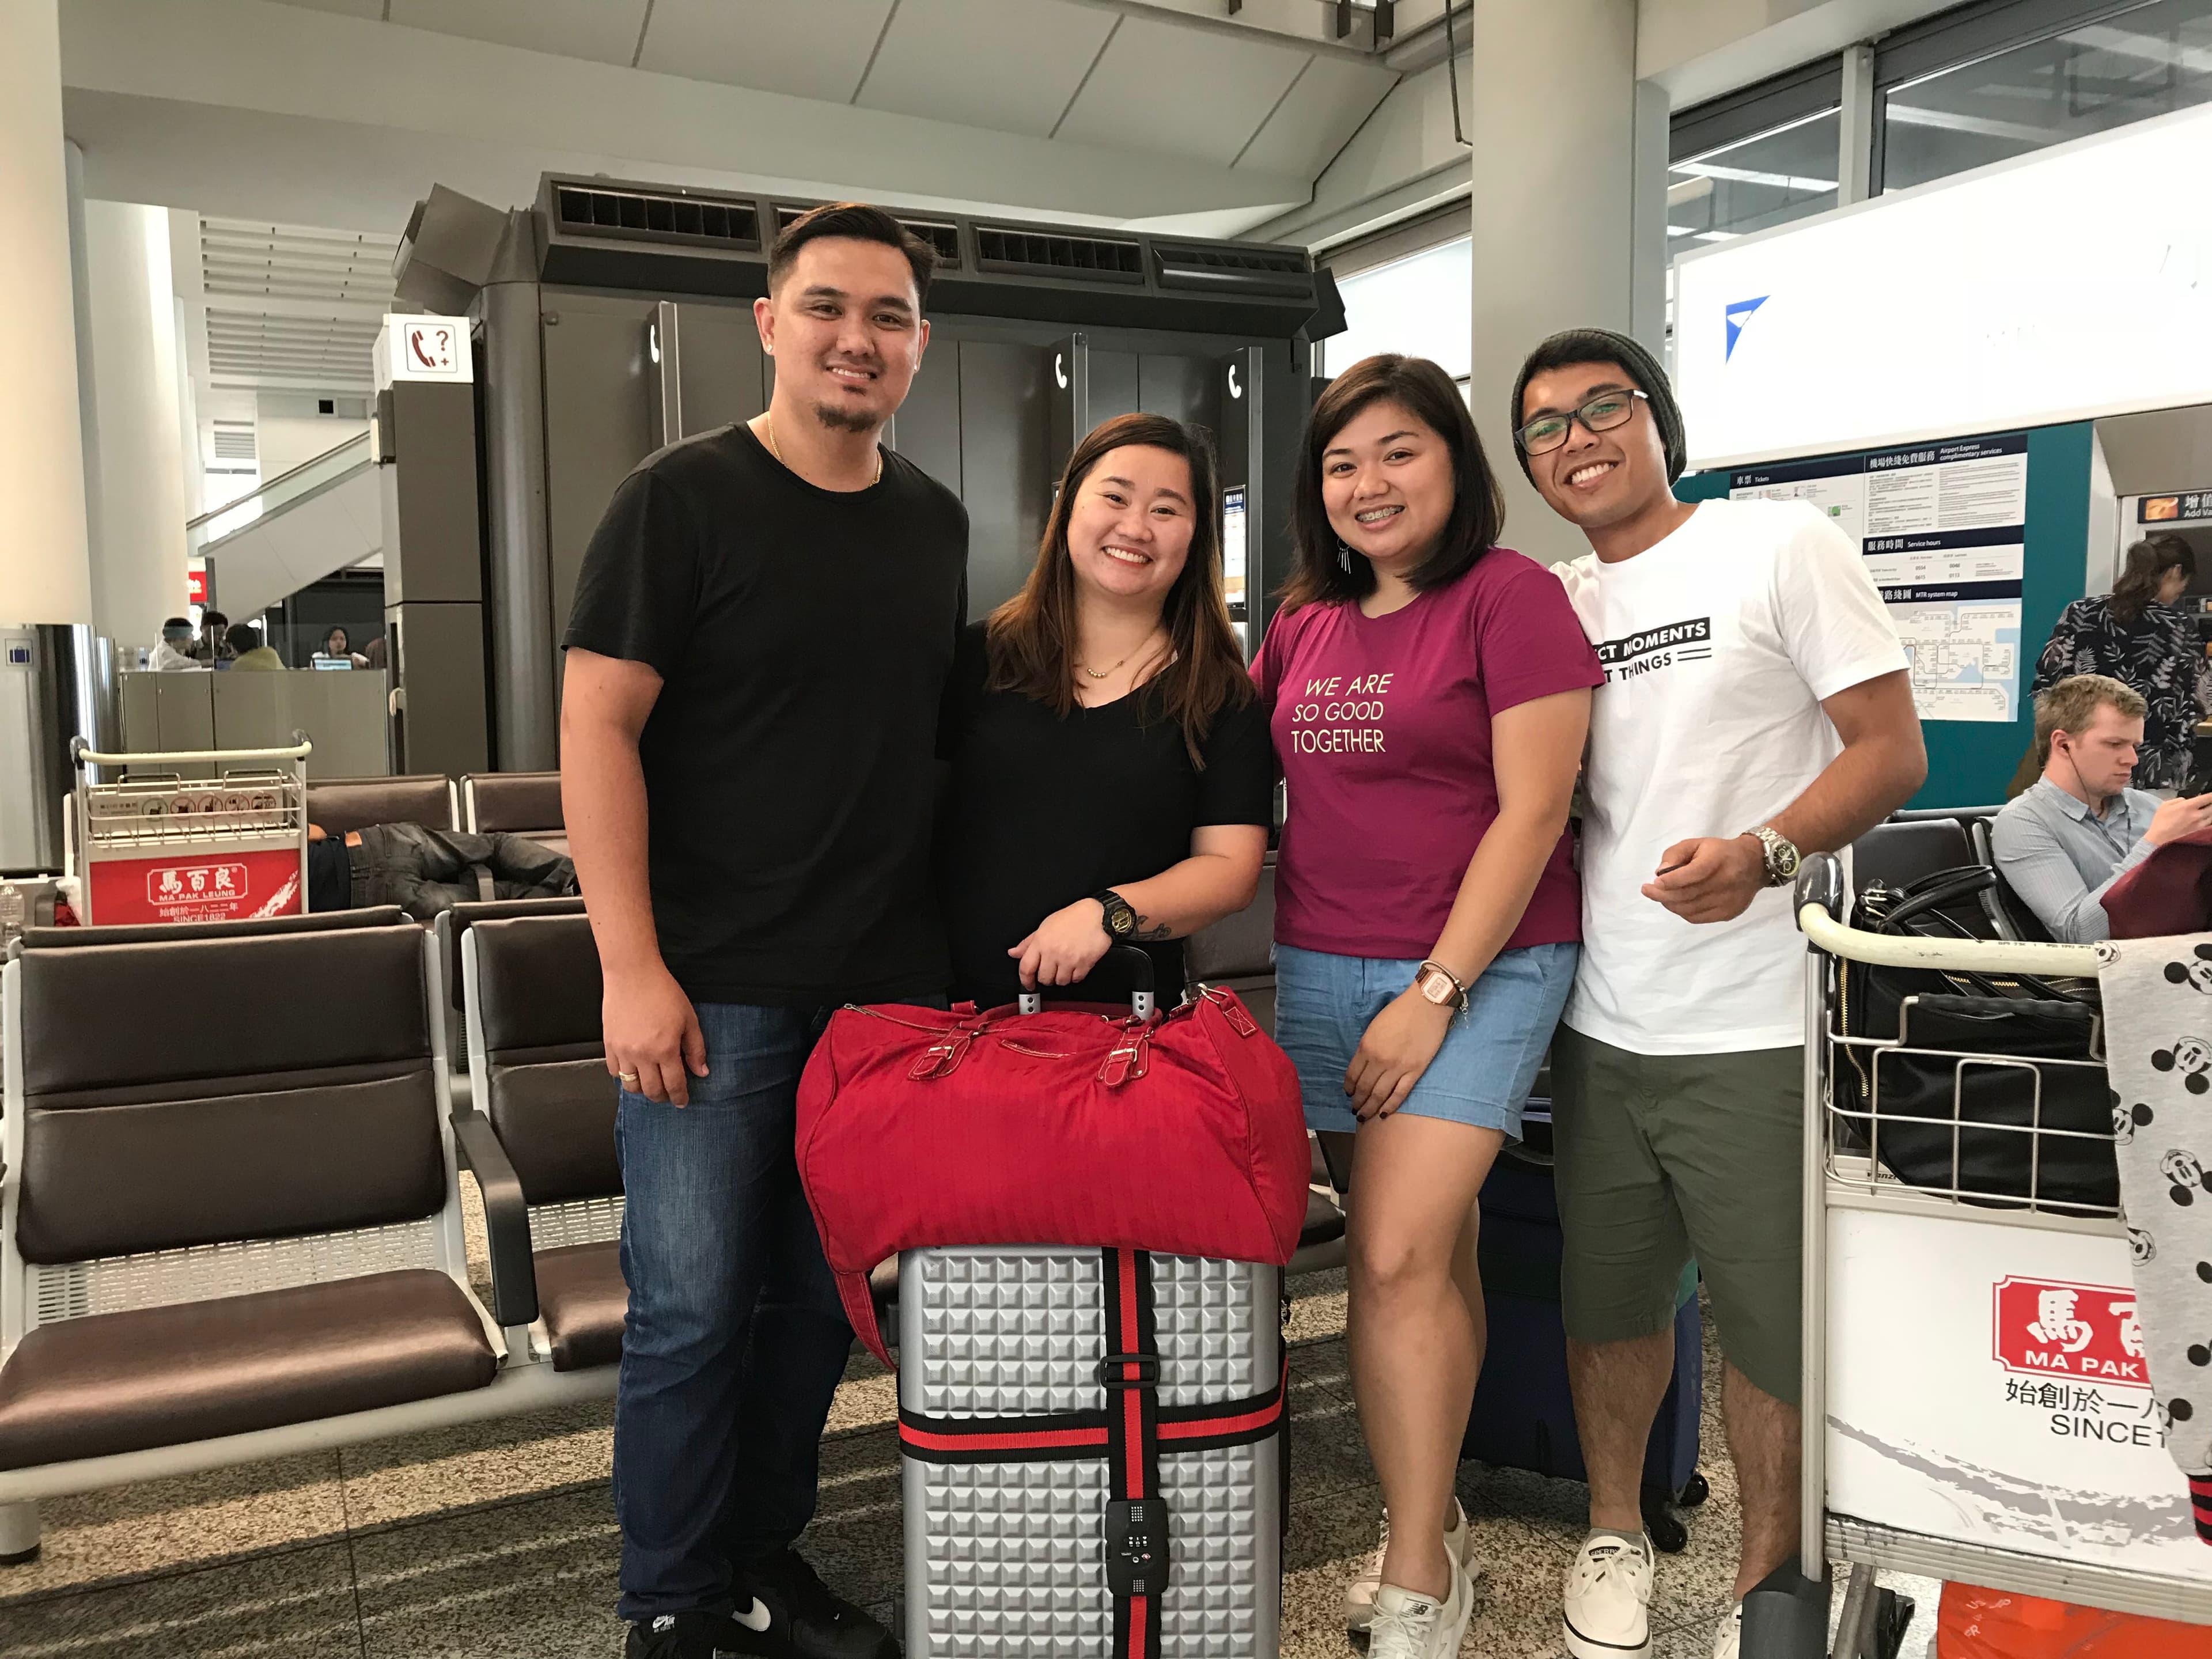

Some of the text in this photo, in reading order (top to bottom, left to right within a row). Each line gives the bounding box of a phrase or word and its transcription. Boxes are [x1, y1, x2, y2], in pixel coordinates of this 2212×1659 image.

[1940, 444, 1980, 454] Airport Express
[1940, 447, 2002, 461] complimentary services
[2184, 509, 2202, 517] Add
[1868, 539, 1904, 551] 服務時間
[1594, 622, 1706, 661] CT MOMENTS
[1619, 652, 1672, 681] THINGS
[1305, 673, 1394, 697] WE ARE
[1292, 701, 1384, 722] SO GOOD
[1291, 729, 1387, 753] TOGETHER
[159, 867, 235, 895] 馬百良
[159, 889, 236, 902] MA PAK LEUNG
[2025, 1350, 2141, 1379] MA PAK
